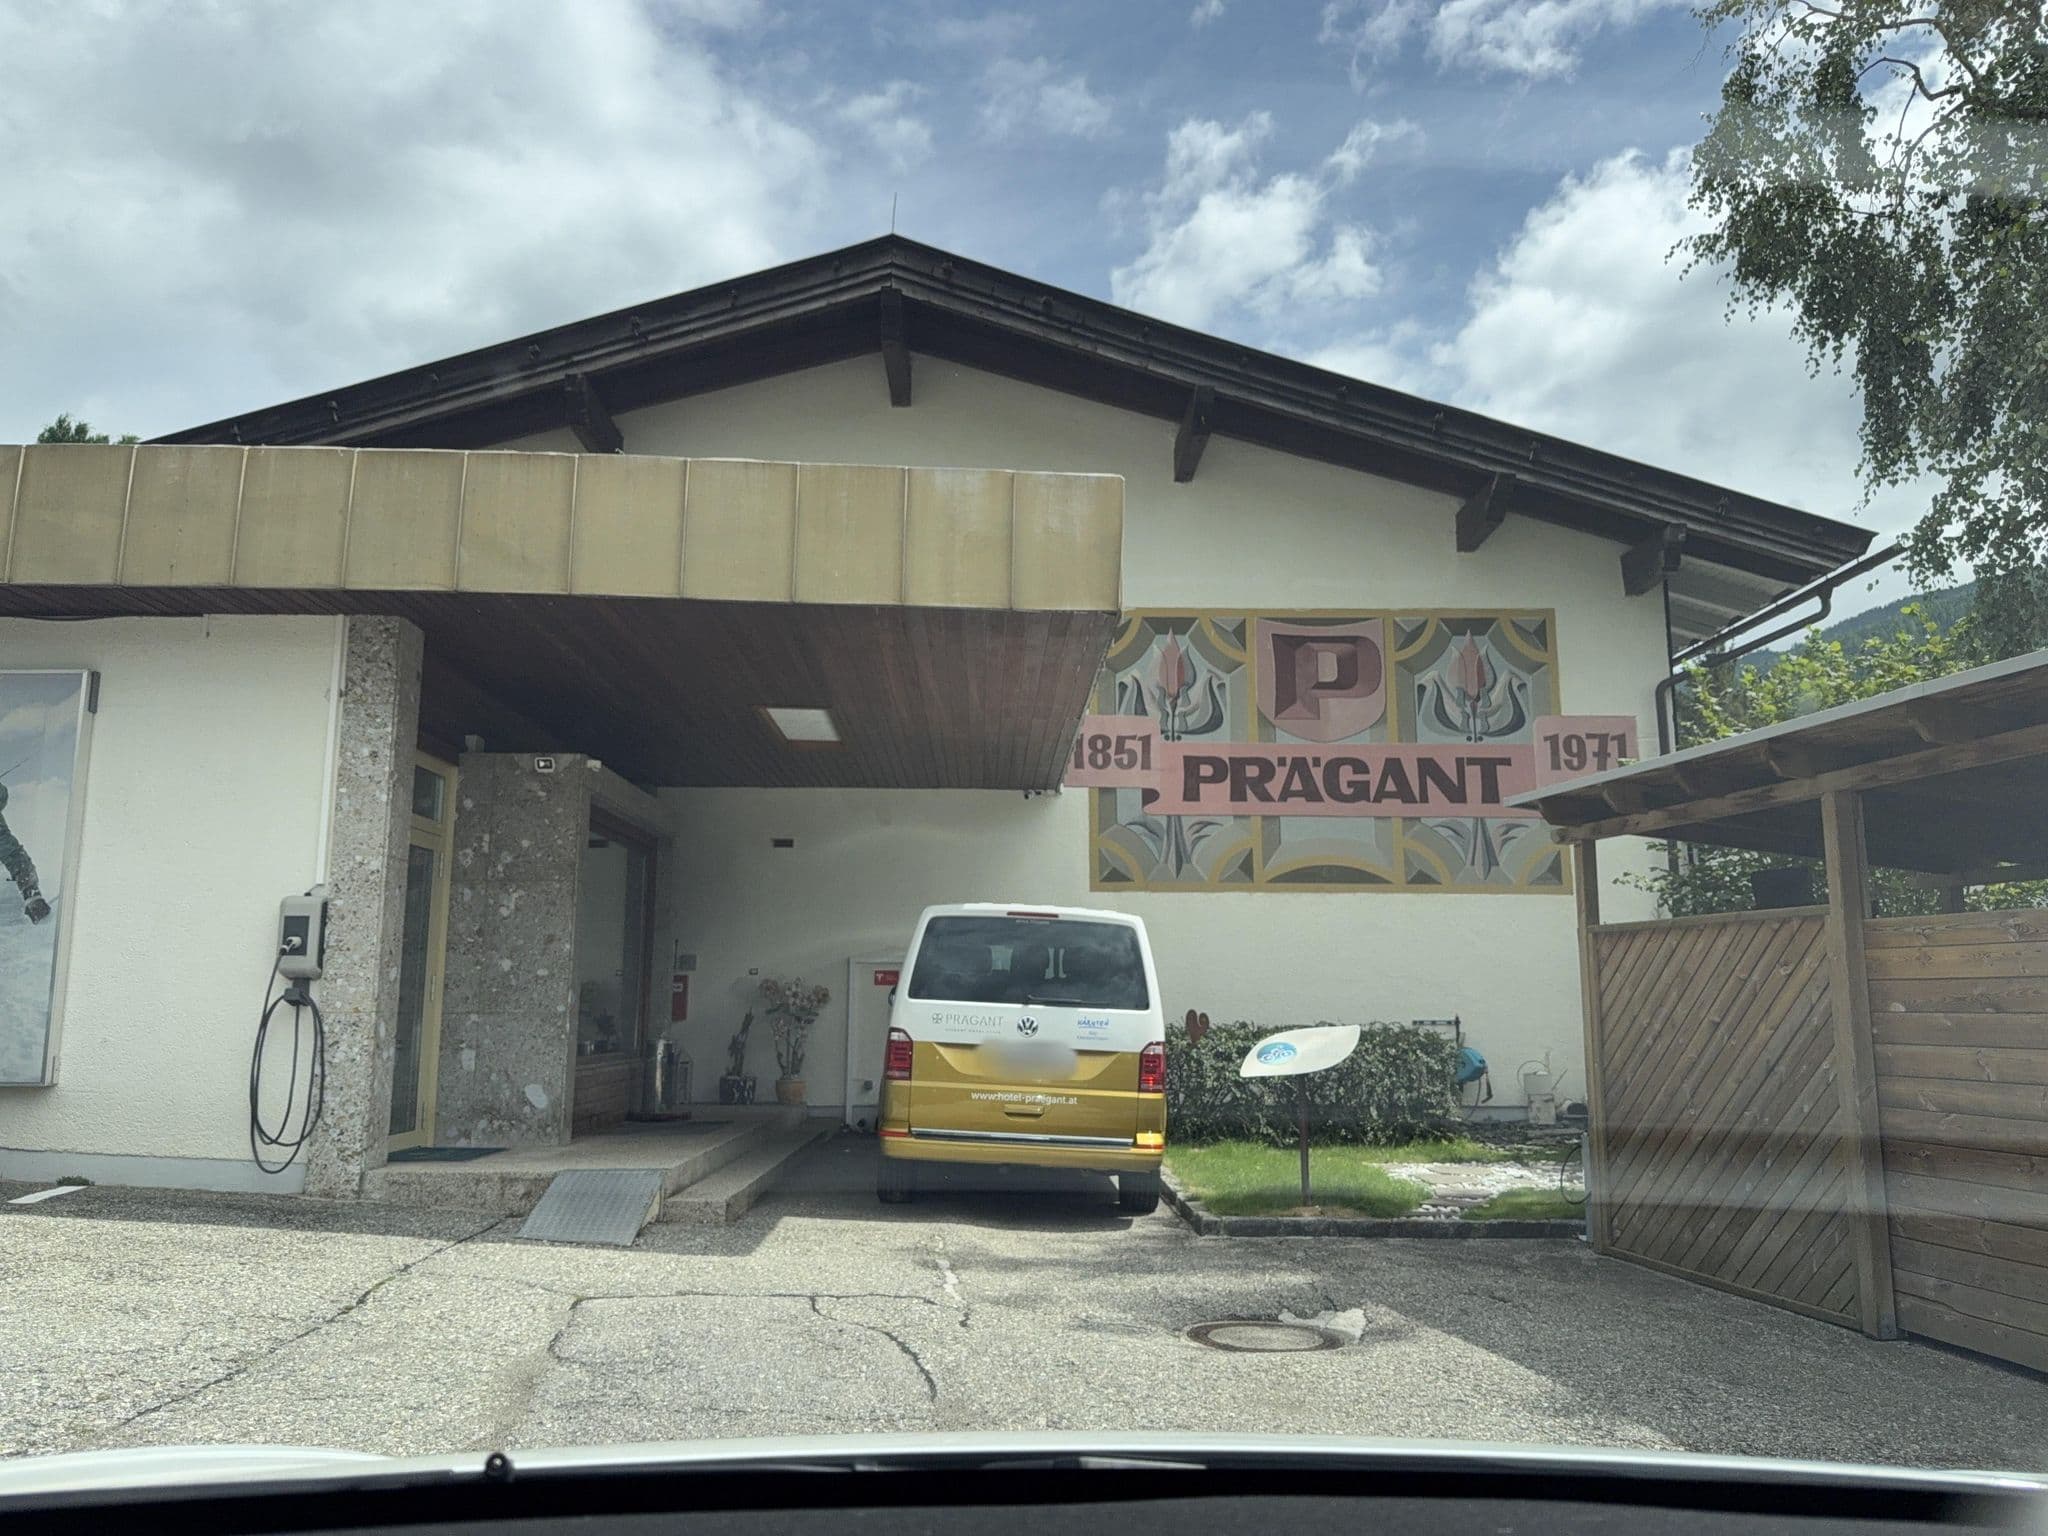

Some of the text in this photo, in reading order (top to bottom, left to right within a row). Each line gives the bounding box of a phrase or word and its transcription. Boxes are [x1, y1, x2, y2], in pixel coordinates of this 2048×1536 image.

[1074, 733, 1152, 770] 1851
[1543, 732, 1627, 771] 1971
[1183, 755, 1512, 804] PRÄGANT
